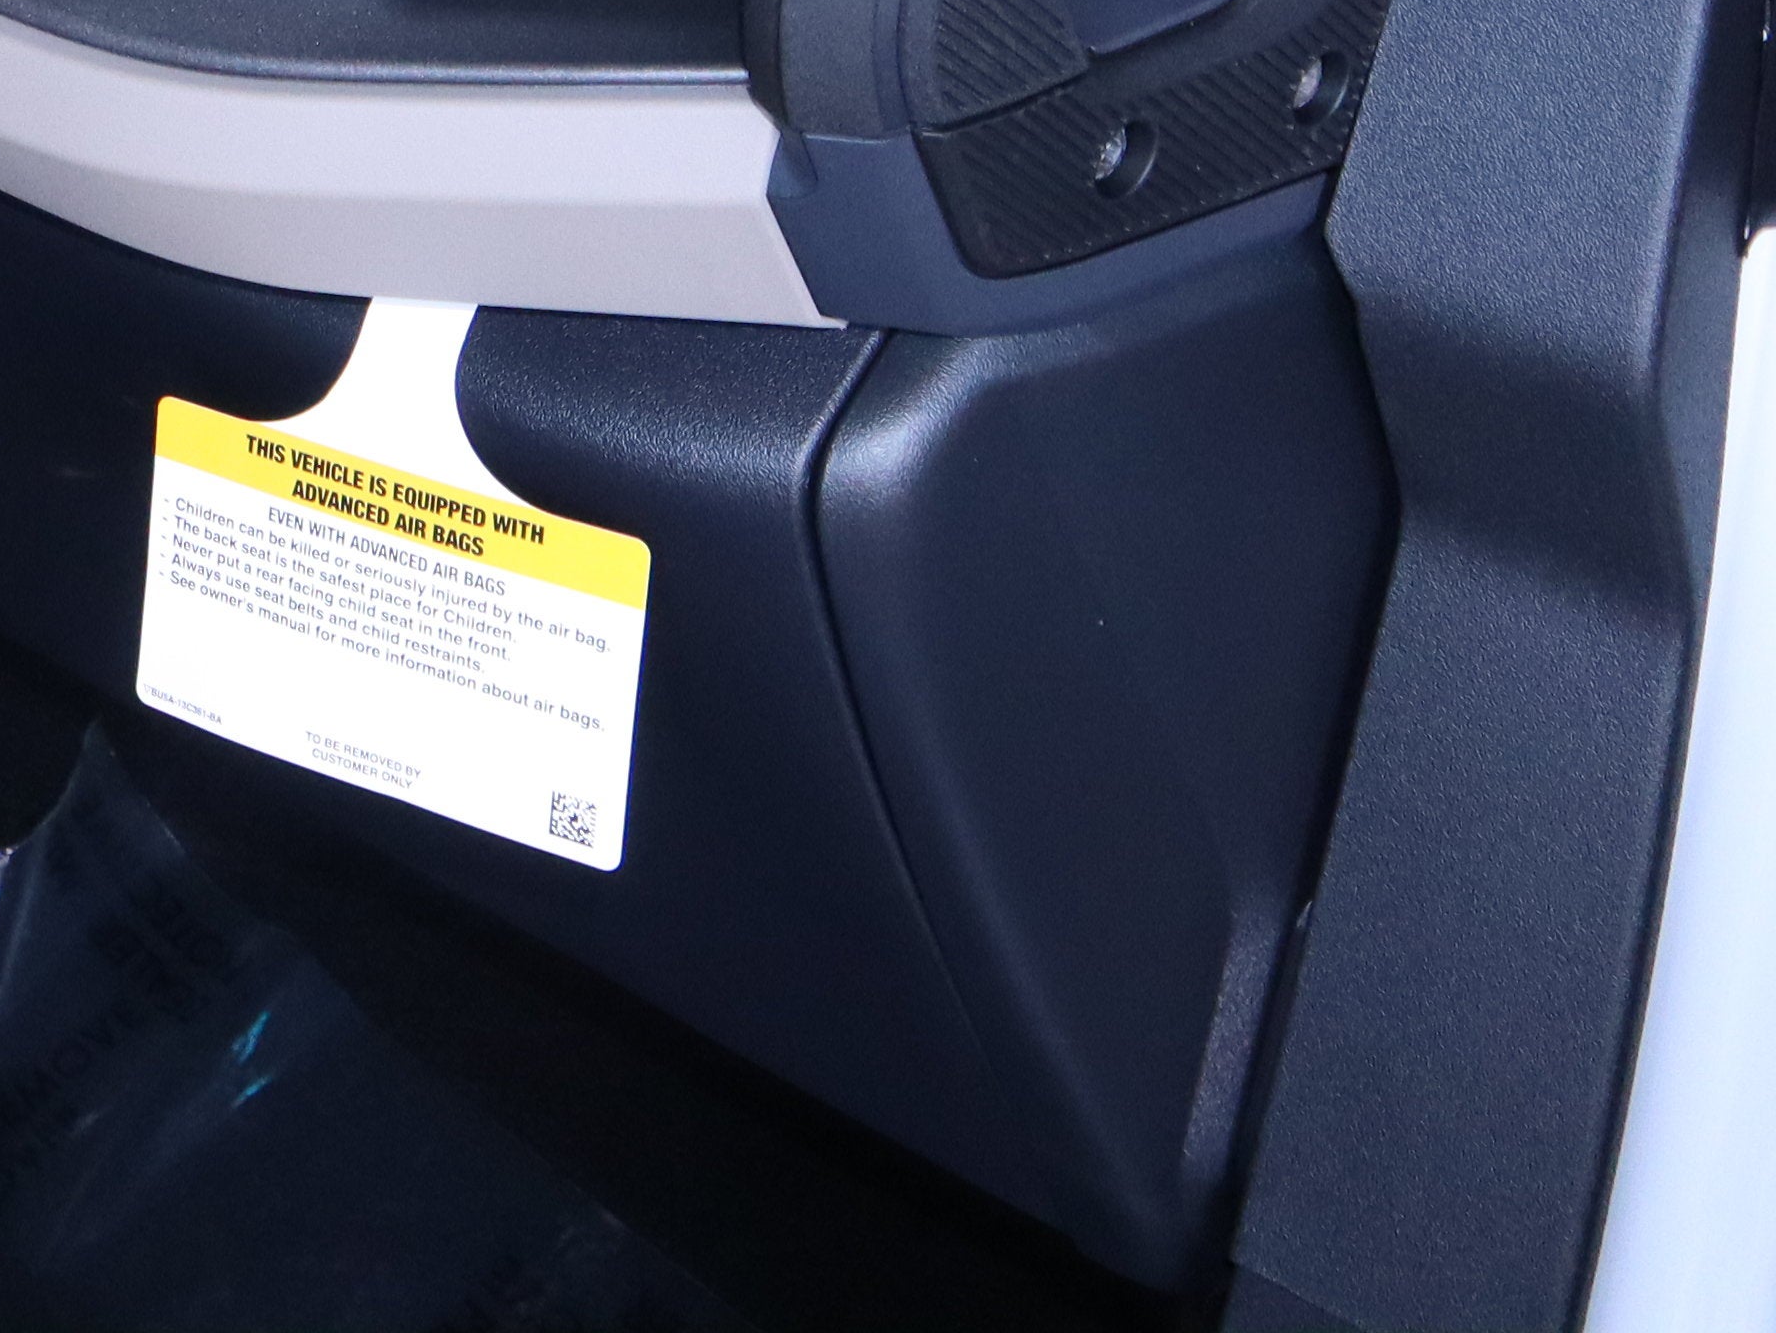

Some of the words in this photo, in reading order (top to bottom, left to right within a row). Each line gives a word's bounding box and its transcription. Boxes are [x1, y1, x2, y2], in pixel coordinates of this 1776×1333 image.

[246, 434, 286, 463] THIS
[291, 449, 364, 491] VEHICLE
[369, 475, 387, 497] IS
[392, 482, 486, 527] EQUIPPED
[492, 512, 544, 545] WITH
[292, 479, 390, 526] ADVANCED
[394, 513, 426, 539] AIR
[432, 523, 484, 556] BAGS
[173, 533, 213, 559] Never
[217, 553, 240, 569] put
[244, 563, 251, 574] a
[257, 568, 284, 585] rear
[289, 577, 334, 607] facing
[339, 597, 376, 617] child
[381, 612, 412, 630] seat
[419, 621, 432, 635] in
[438, 627, 462, 645] the
[468, 637, 511, 661] front.
[174, 515, 199, 535] The
[204, 527, 237, 549] back
[242, 543, 270, 562] seat
[276, 553, 287, 567] is
[292, 559, 314, 577] the
[320, 571, 364, 594] safest
[370, 589, 411, 609] place
[417, 601, 438, 617] for
[444, 609, 519, 643] Children.
[176, 497, 234, 529] Children
[239, 523, 264, 539] can
[269, 531, 286, 547] be
[291, 539, 330, 563] killed
[335, 557, 350, 568] or
[356, 563, 426, 597] seriously
[432, 585, 487, 613] injured
[493, 604, 512, 623] by
[518, 613, 543, 630] the
[549, 624, 569, 637] air
[576, 629, 612, 653] bag.
[269, 507, 303, 531] EVEN
[309, 521, 345, 545] WITH
[350, 535, 427, 571] ADVANCED
[433, 563, 458, 582] AIR
[464, 571, 505, 595] BAGS
[170, 571, 195, 591] See
[200, 585, 253, 613] owner's
[259, 607, 310, 635] manual
[316, 625, 336, 642] for
[342, 637, 380, 657] more
[386, 649, 476, 689] information
[482, 683, 528, 706] about
[534, 700, 554, 713] air
[560, 705, 604, 729] bags.
[172, 553, 221, 581] Always
[226, 576, 250, 592] use
[255, 587, 284, 606] seat
[289, 597, 324, 619] belts
[329, 614, 357, 631] and
[362, 625, 400, 645] child
[405, 639, 485, 673] restraints.
[306, 731, 320, 744] TO
[325, 738, 338, 750] BE
[344, 745, 401, 771] REMOVED
[406, 766, 420, 777] BY
[312, 749, 377, 777] CUSTOMER
[382, 771, 412, 788] ONLY
